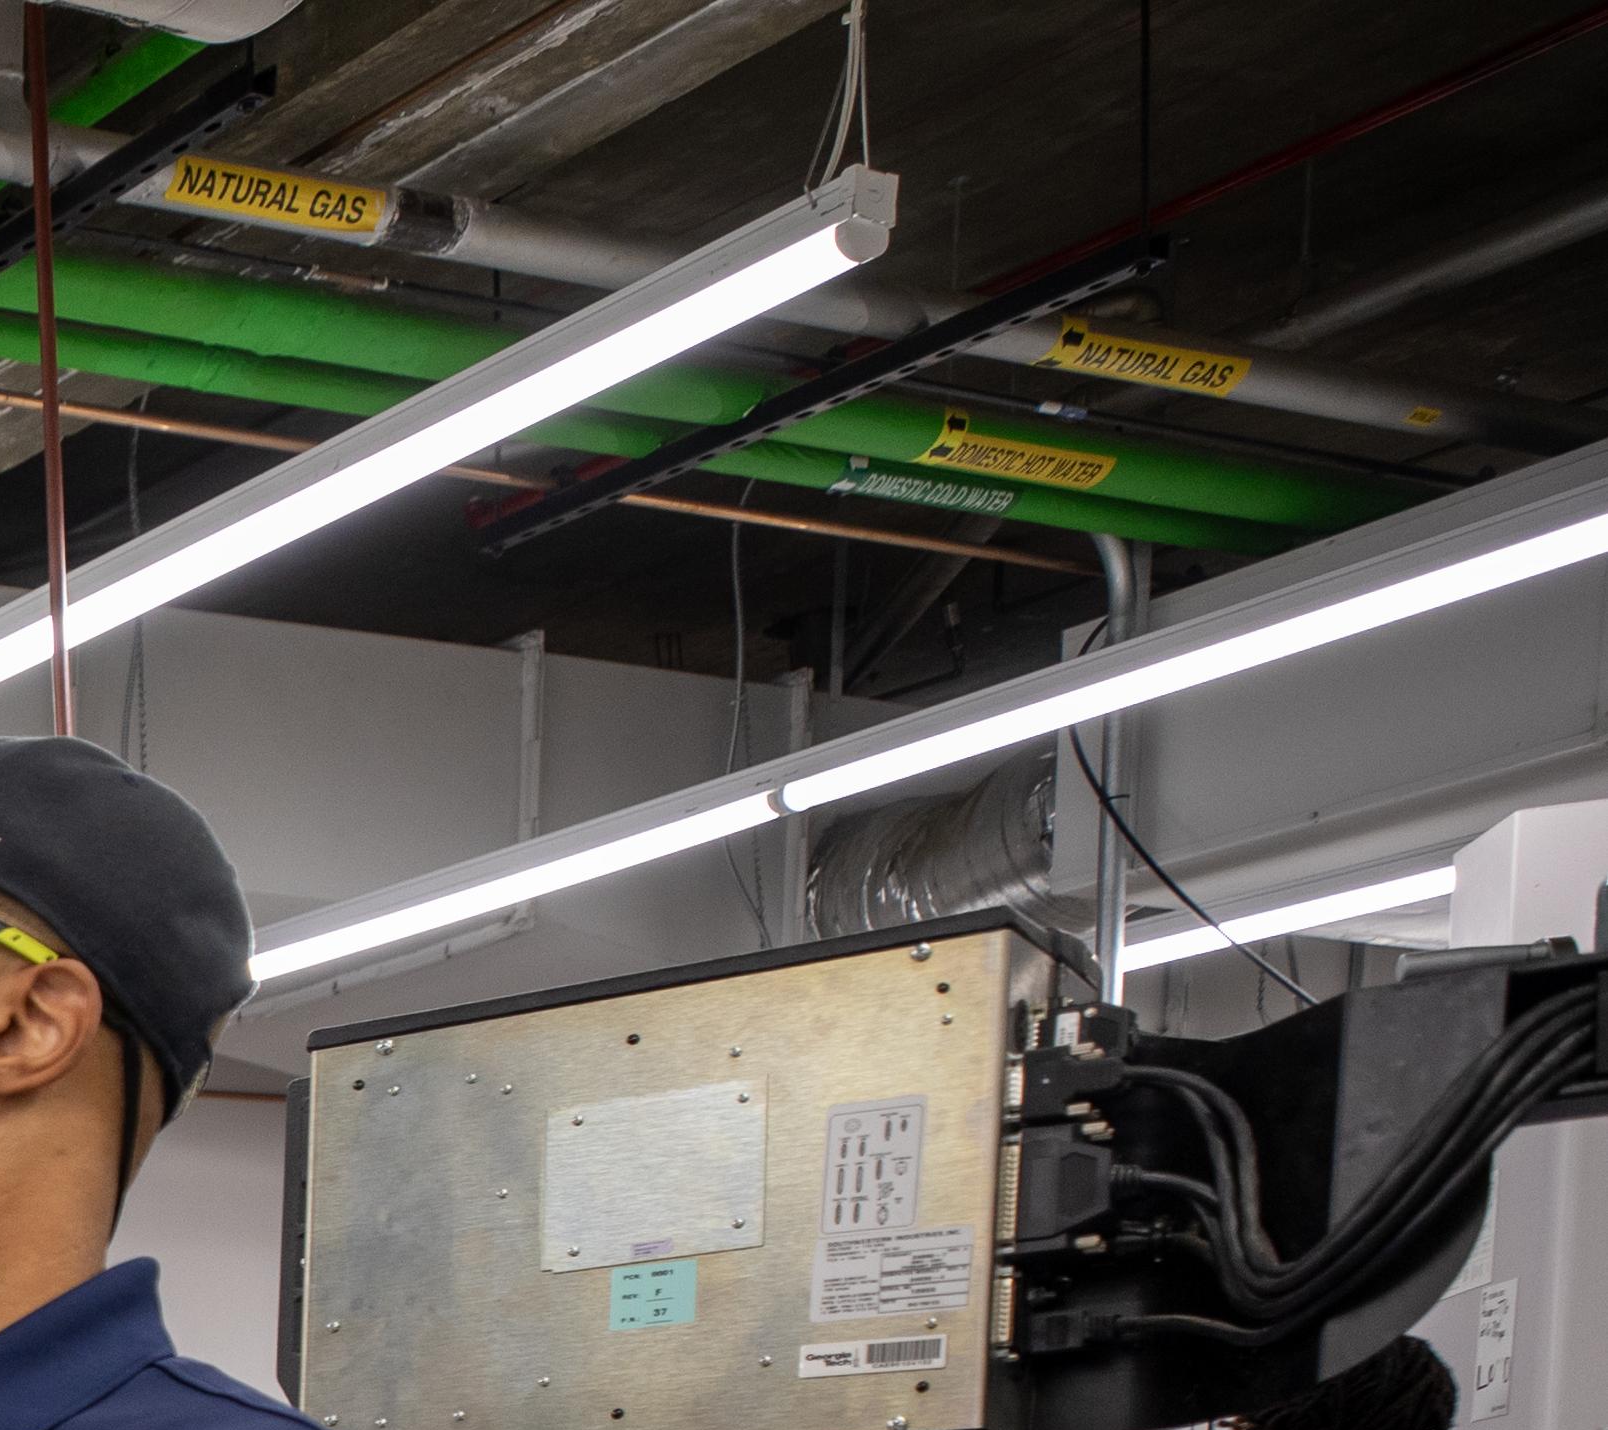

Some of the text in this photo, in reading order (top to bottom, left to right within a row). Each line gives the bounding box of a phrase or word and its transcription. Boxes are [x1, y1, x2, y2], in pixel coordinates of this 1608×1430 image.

[177, 163, 367, 224] NATURAL GAS
[1078, 341, 1235, 389] NATURAL GAS
[948, 441, 1105, 484] DOMESTIC HOT WATER
[860, 473, 1015, 513] DOMESTIC COLD WATER
[653, 1308, 667, 1317] 37
[805, 1352, 852, 1362] Georgia
[825, 1359, 852, 1368] Tech
